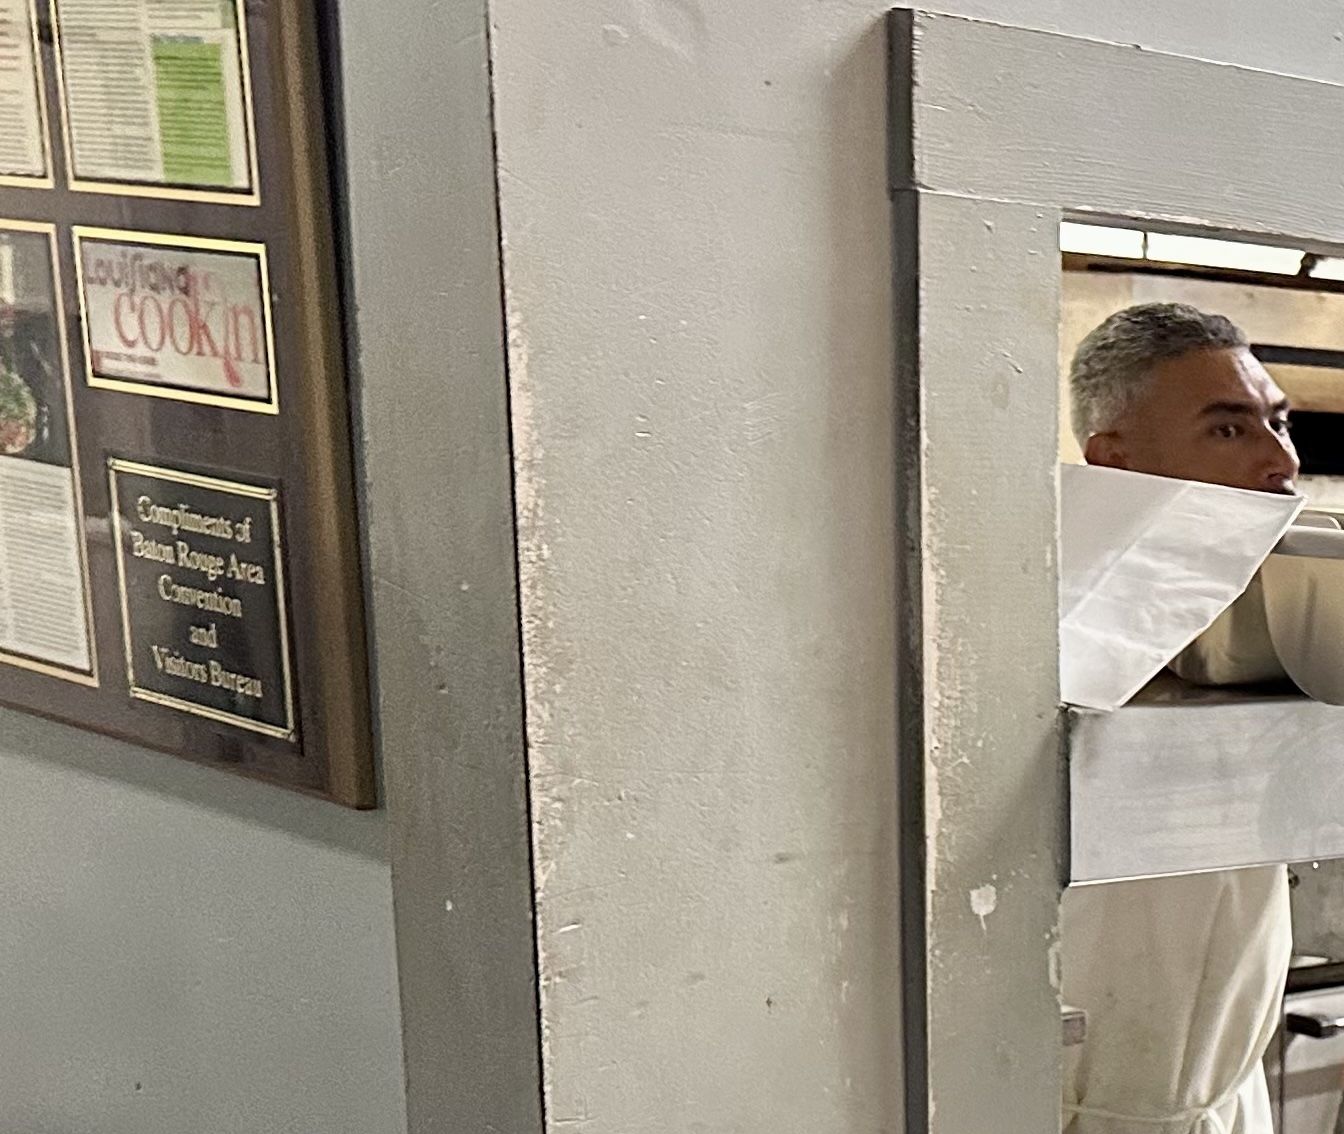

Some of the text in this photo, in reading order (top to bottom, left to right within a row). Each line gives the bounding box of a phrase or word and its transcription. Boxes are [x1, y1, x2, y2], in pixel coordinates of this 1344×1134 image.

[138, 495, 252, 543] Compliments of
[130, 530, 265, 585] Baton Rouge Area
[158, 574, 242, 618] Convention
[189, 622, 218, 648] and
[151, 645, 263, 698] Visitors Bureau
